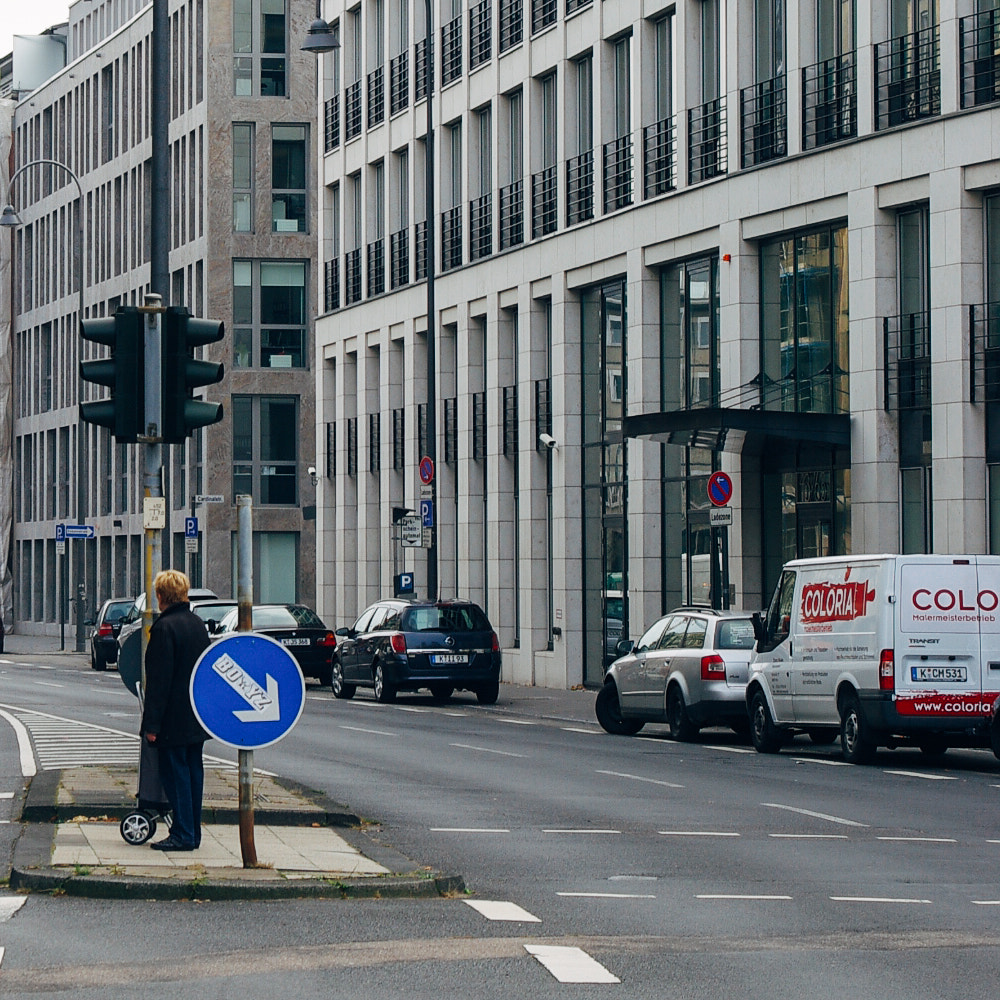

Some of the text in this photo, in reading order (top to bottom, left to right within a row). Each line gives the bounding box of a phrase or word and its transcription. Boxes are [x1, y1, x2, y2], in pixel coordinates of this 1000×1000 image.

[187, 520, 194, 534] P
[402, 576, 411, 587] P
[804, 588, 853, 617] COLORIA
[912, 589, 999, 611] COLO
[912, 614, 996, 622] Malermeisterbetrieb
